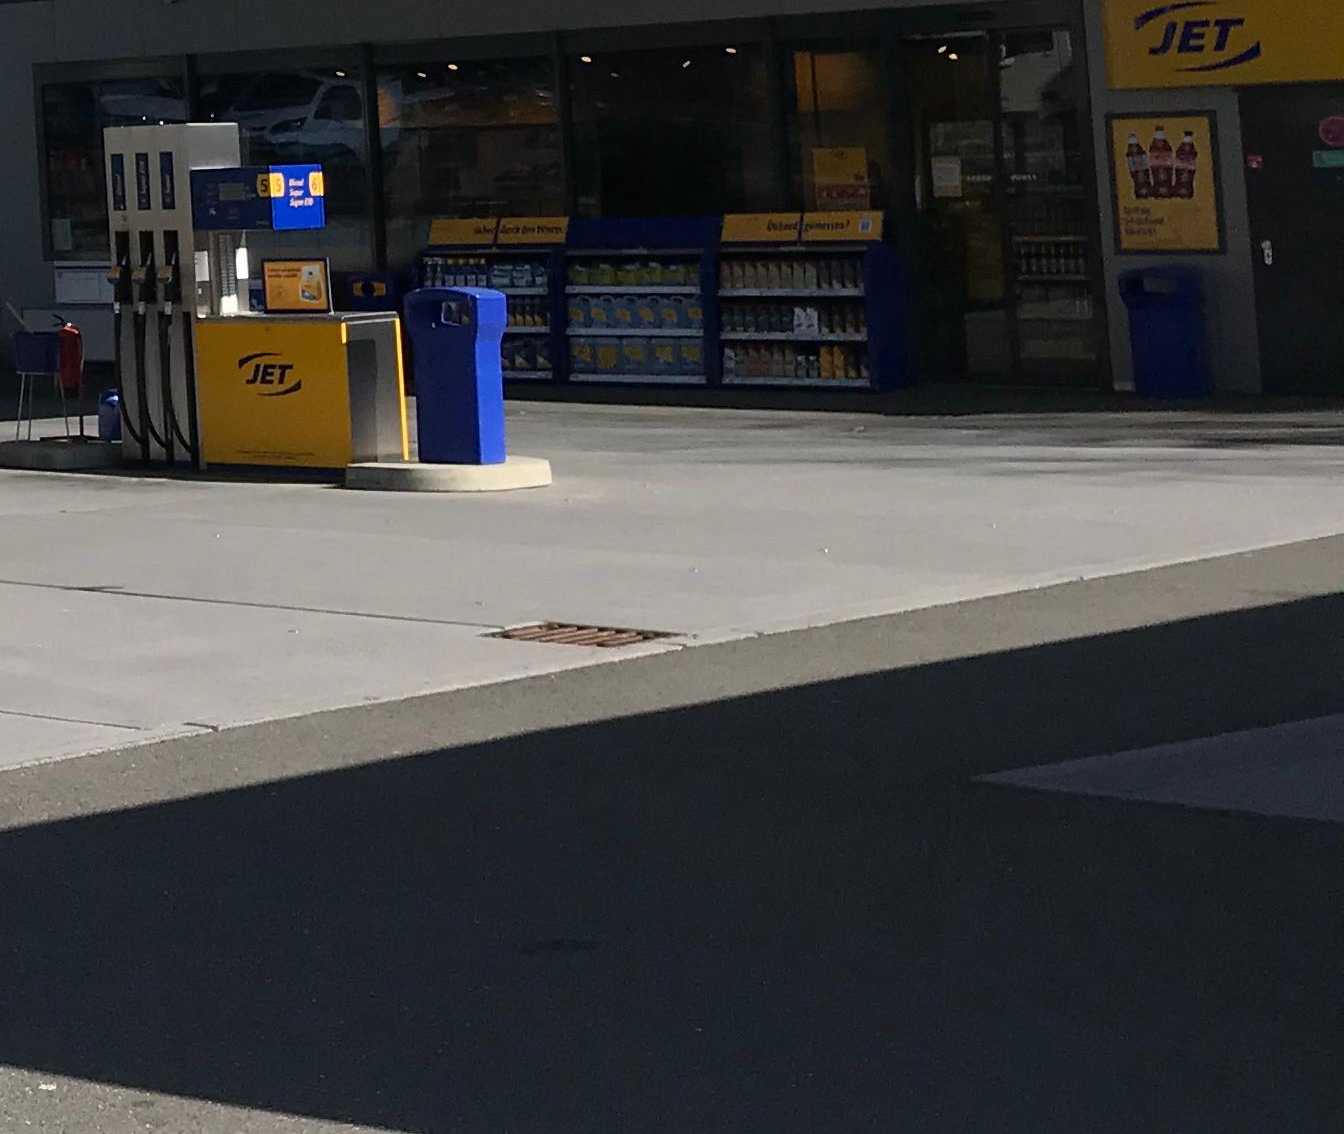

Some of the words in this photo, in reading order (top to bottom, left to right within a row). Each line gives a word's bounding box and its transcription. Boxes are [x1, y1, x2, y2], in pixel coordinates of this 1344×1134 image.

[1148, 17, 1245, 55] JET
[260, 178, 268, 193] 5
[245, 363, 294, 385] JET
